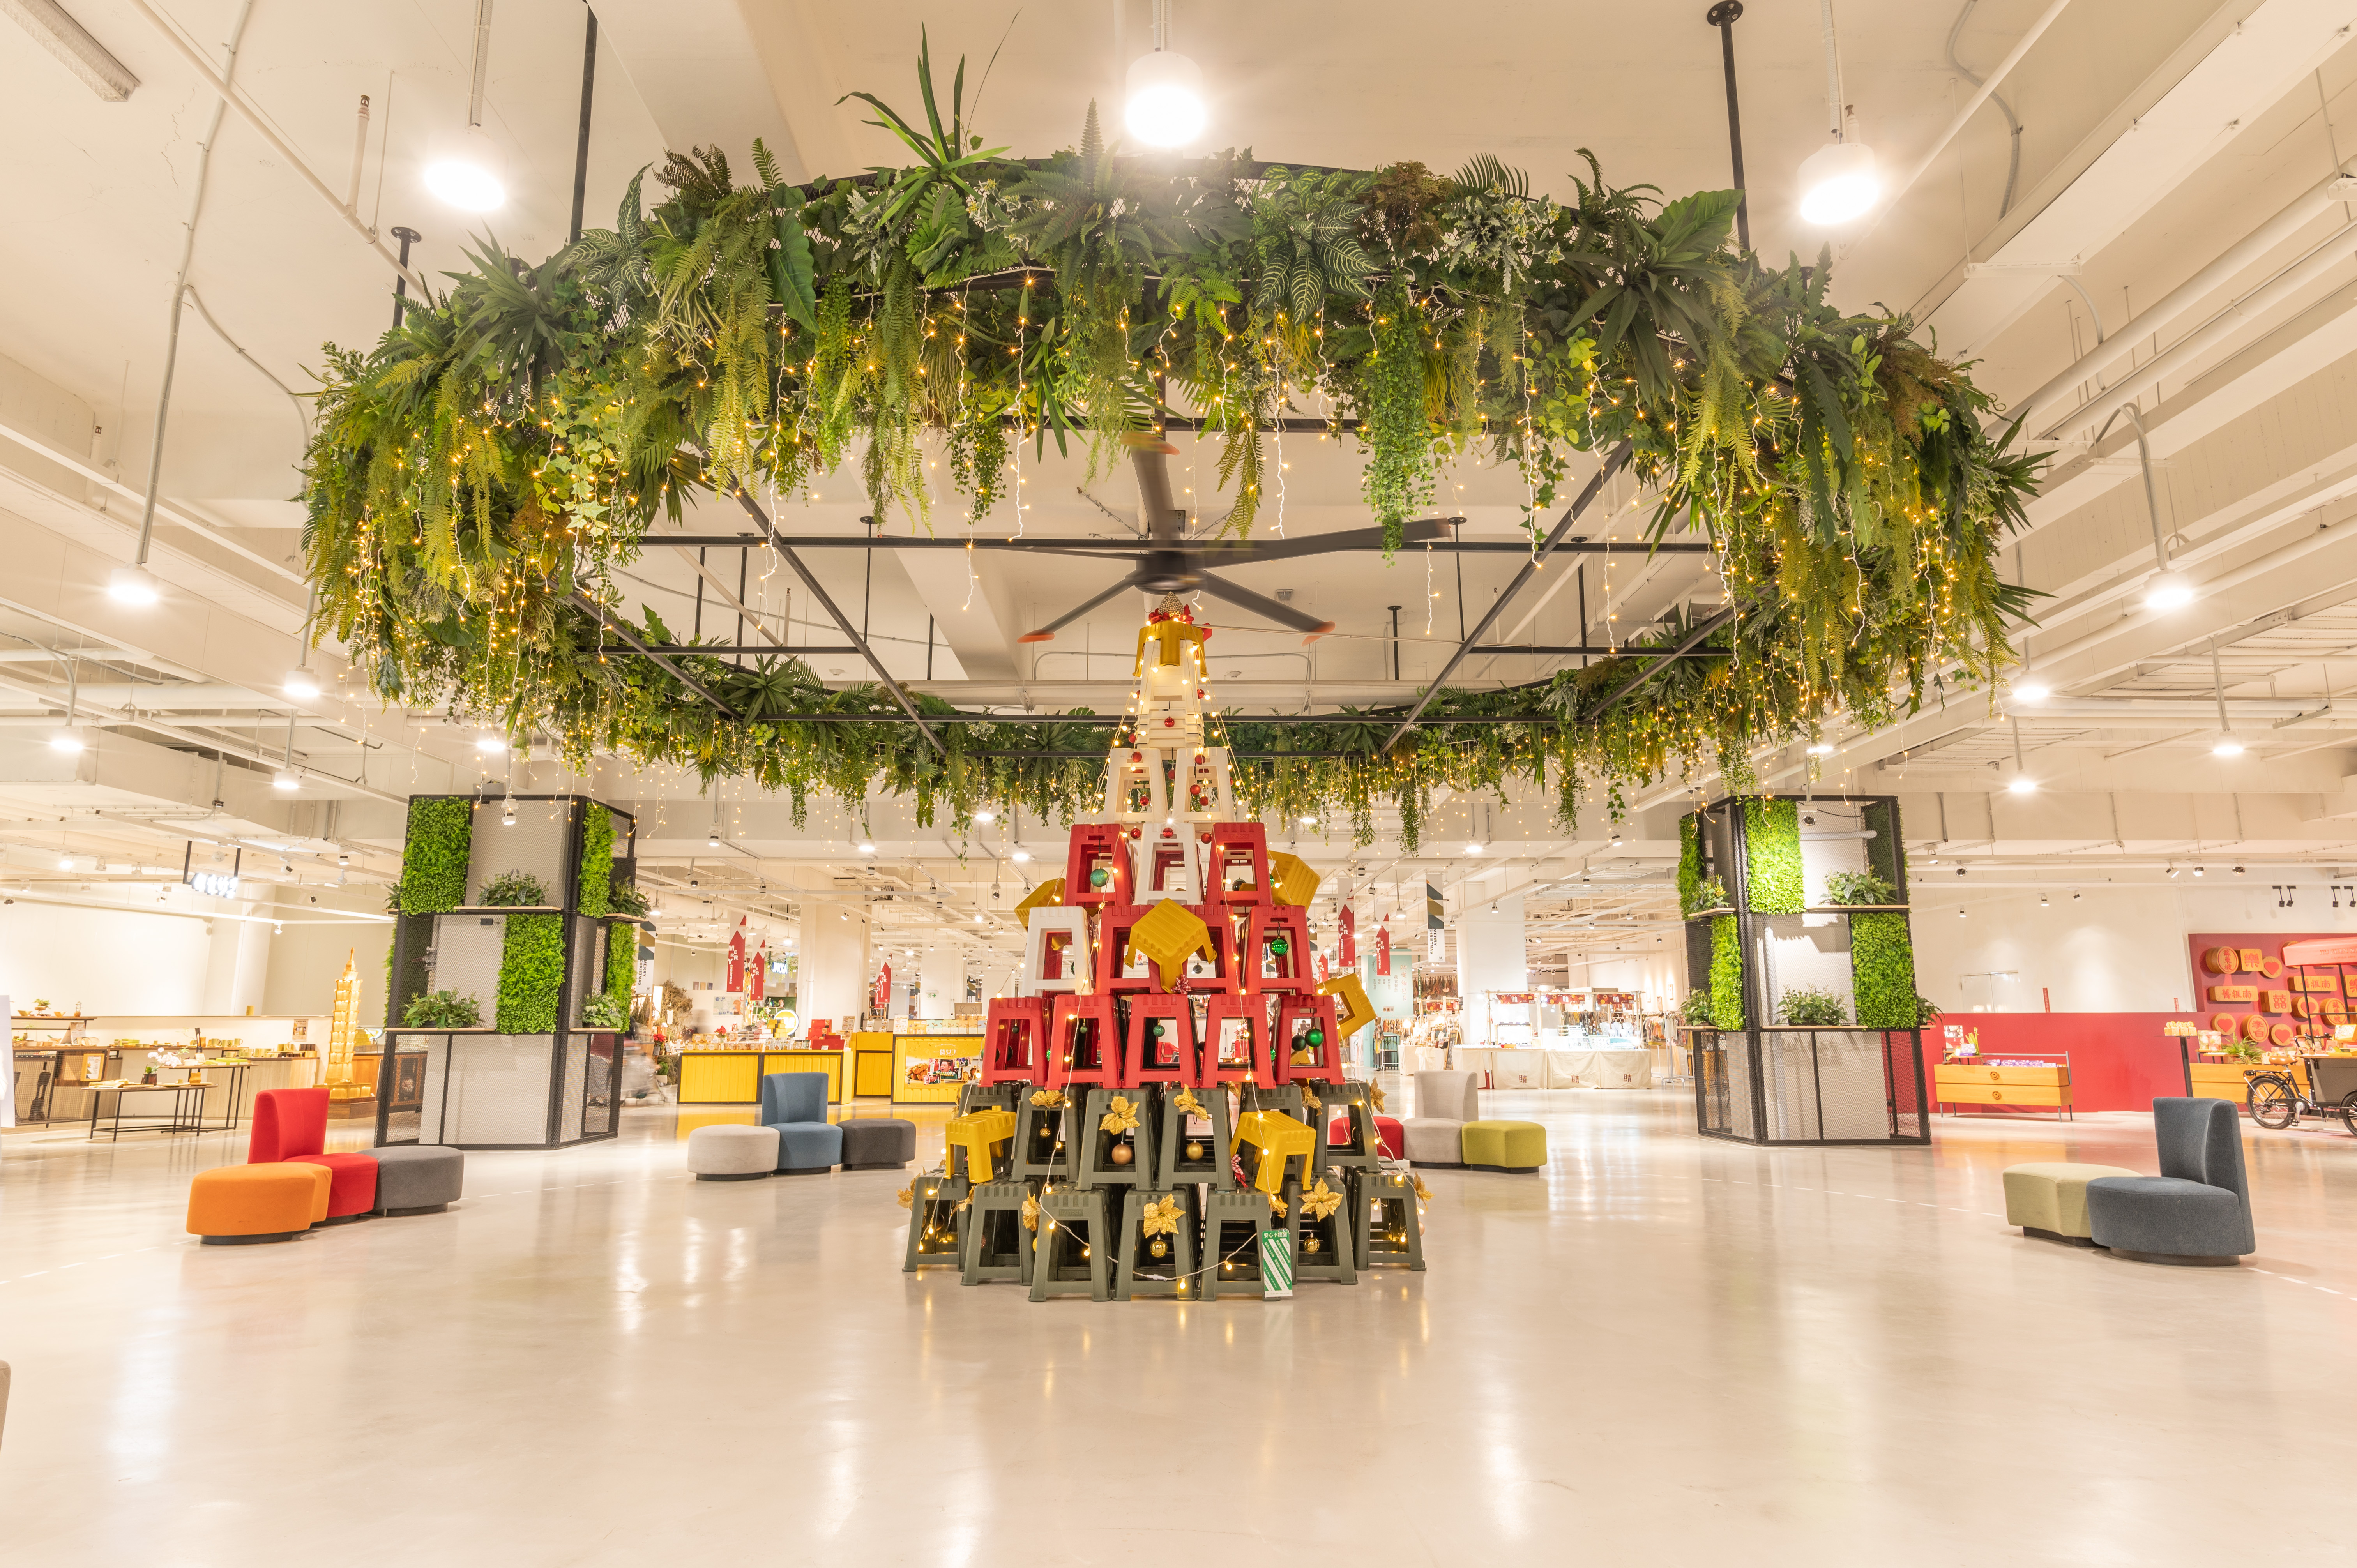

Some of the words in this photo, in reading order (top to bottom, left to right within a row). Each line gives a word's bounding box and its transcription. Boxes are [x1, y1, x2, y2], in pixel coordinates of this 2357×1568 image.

[1338, 919, 1348, 939] MERRY
[1376, 937, 1385, 953] MERRY
[728, 945, 738, 965] MERRY
[2244, 952, 2260, 968] 樂
[751, 963, 759, 979] MERRY
[2222, 989, 2252, 999] 舊振南
[2252, 1020, 2265, 1038] 李白
